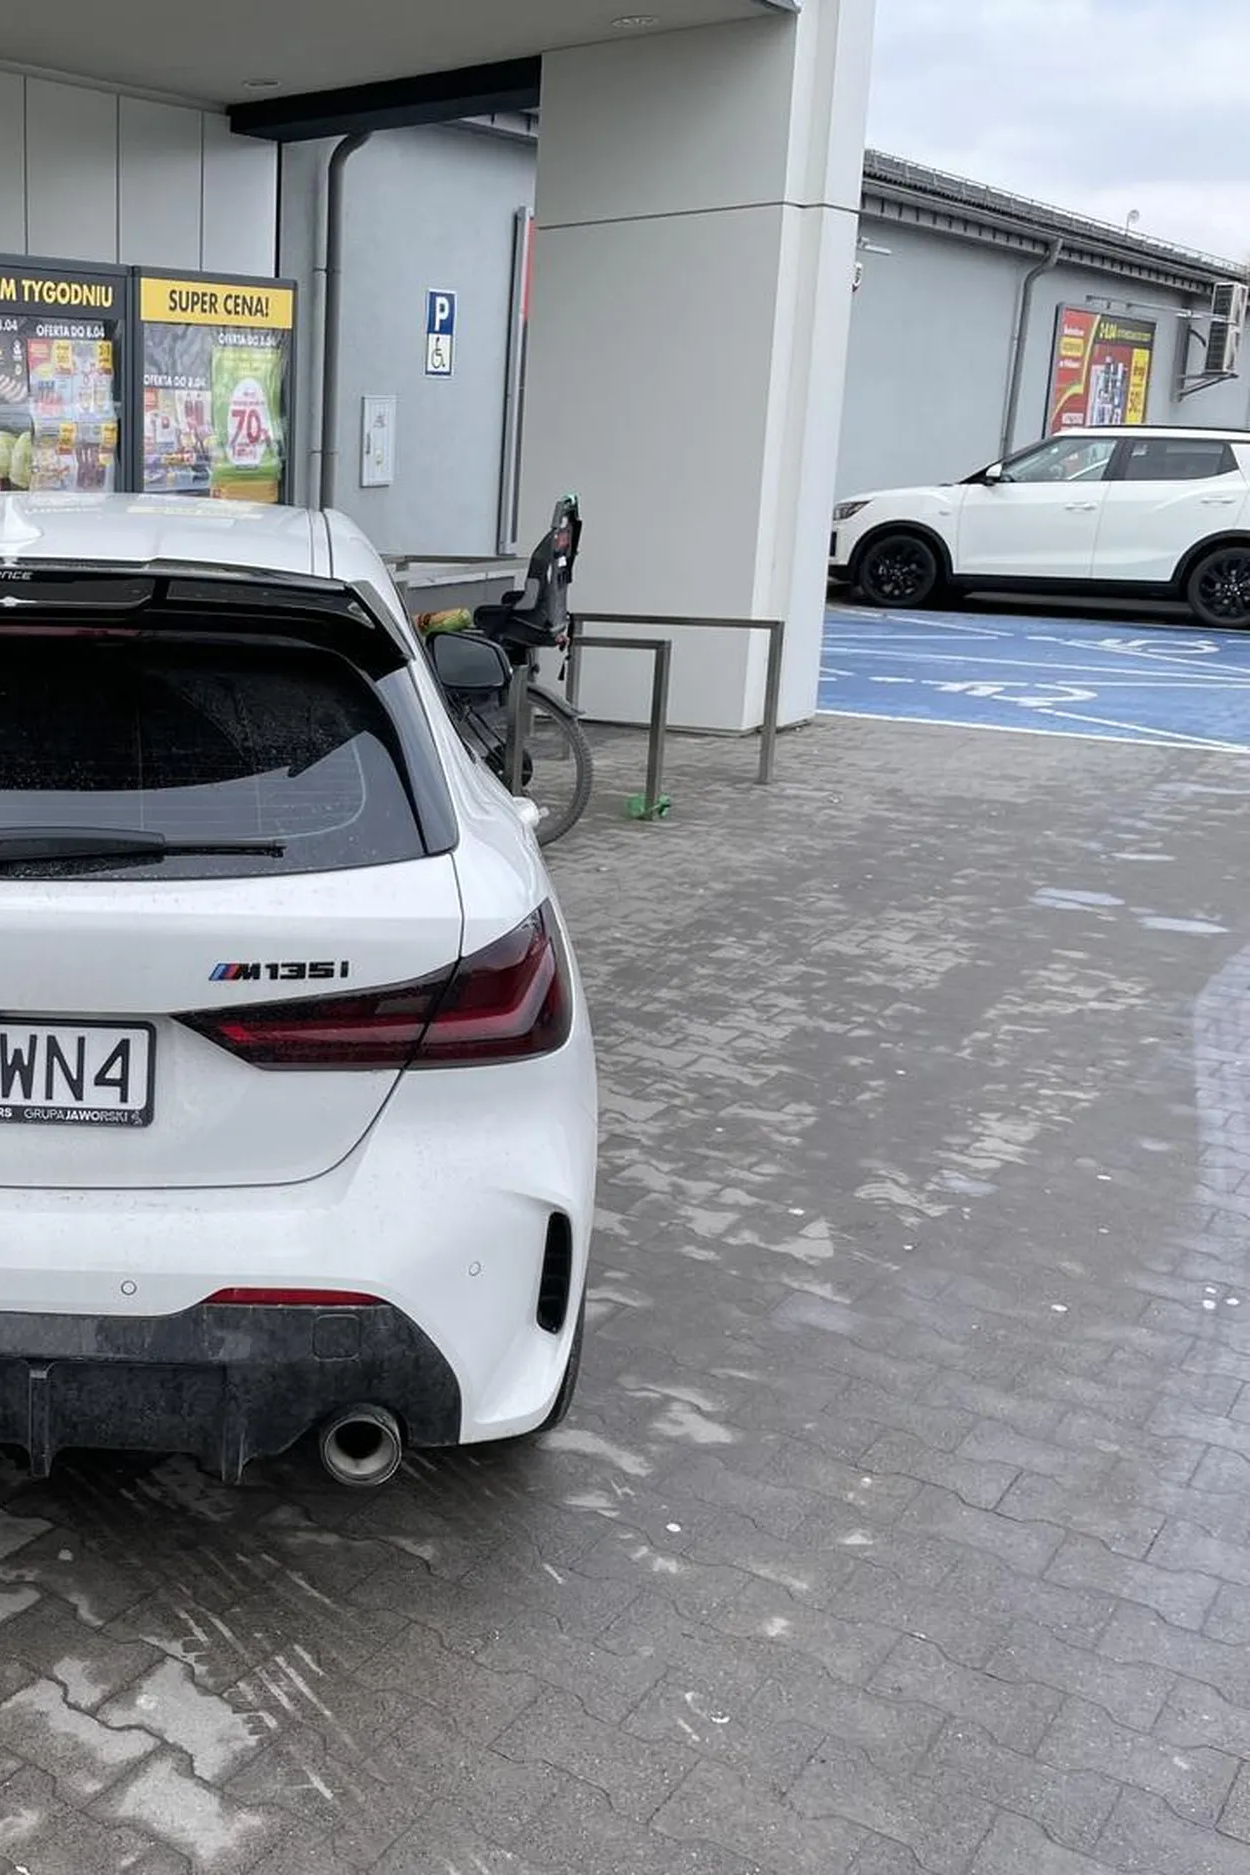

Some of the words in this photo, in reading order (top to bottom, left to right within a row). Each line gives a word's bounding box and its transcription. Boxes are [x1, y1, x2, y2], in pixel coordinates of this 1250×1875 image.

[22, 280, 113, 308] TYGODNIU
[168, 289, 218, 314] SUPER
[223, 293, 269, 318] CENA!
[435, 297, 449, 331] P
